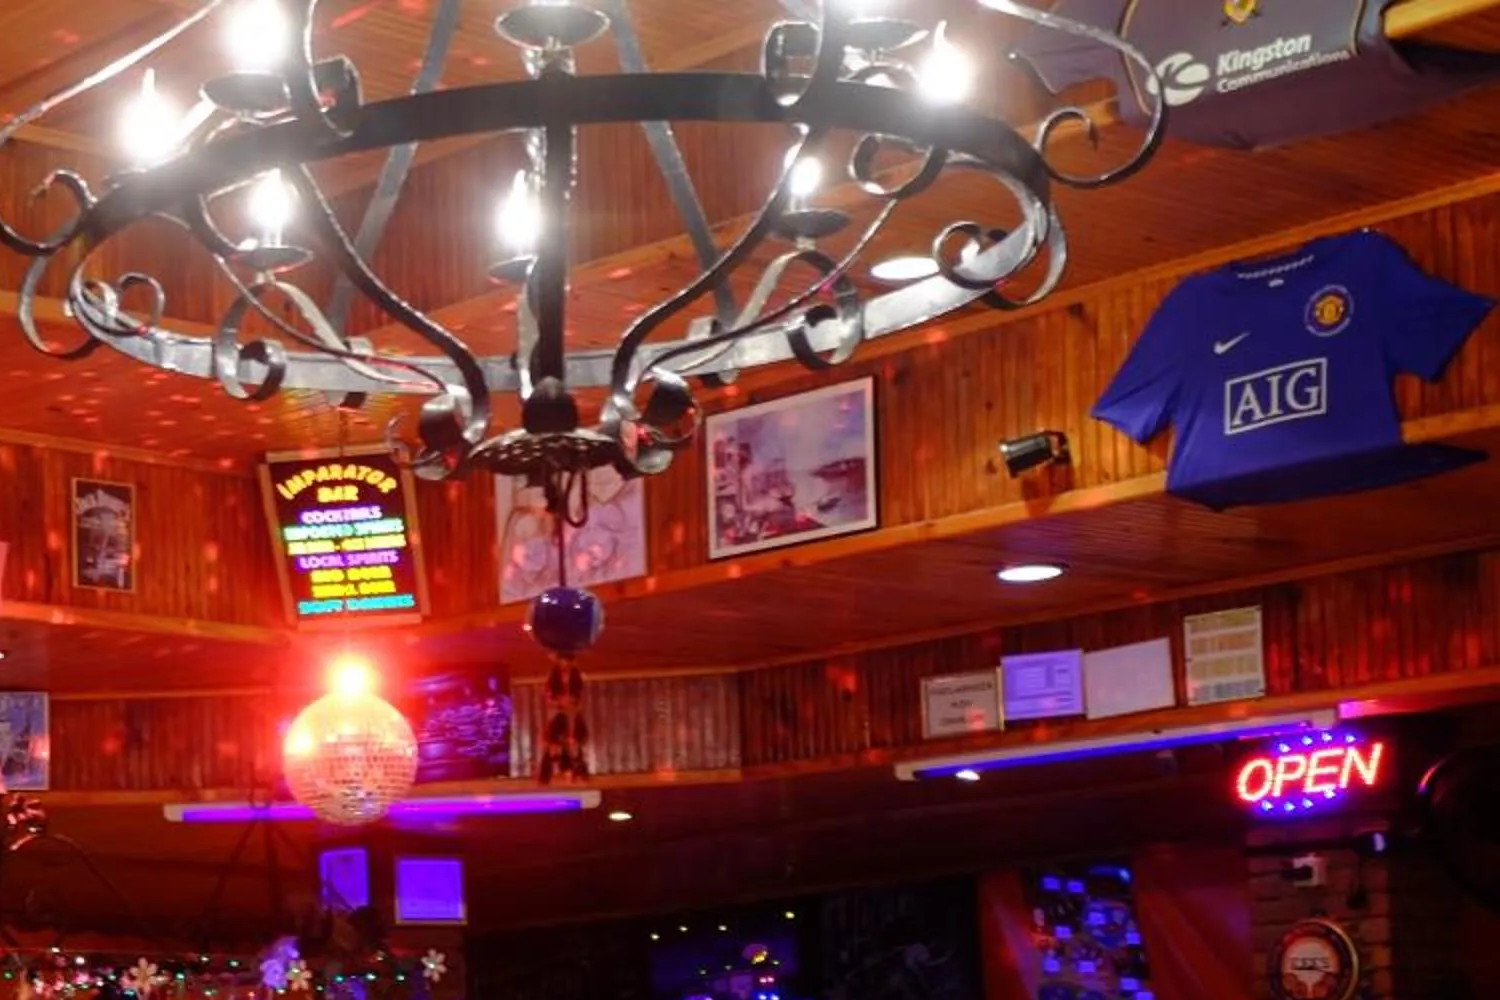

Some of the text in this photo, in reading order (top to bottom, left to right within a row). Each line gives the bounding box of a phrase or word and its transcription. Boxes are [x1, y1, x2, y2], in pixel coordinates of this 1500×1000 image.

[1217, 34, 1312, 76] Kingston
[1217, 49, 1351, 93] Communications
[1232, 367, 1319, 425] AIG
[317, 485, 359, 502] BAR
[1237, 743, 1383, 801] OPEN
